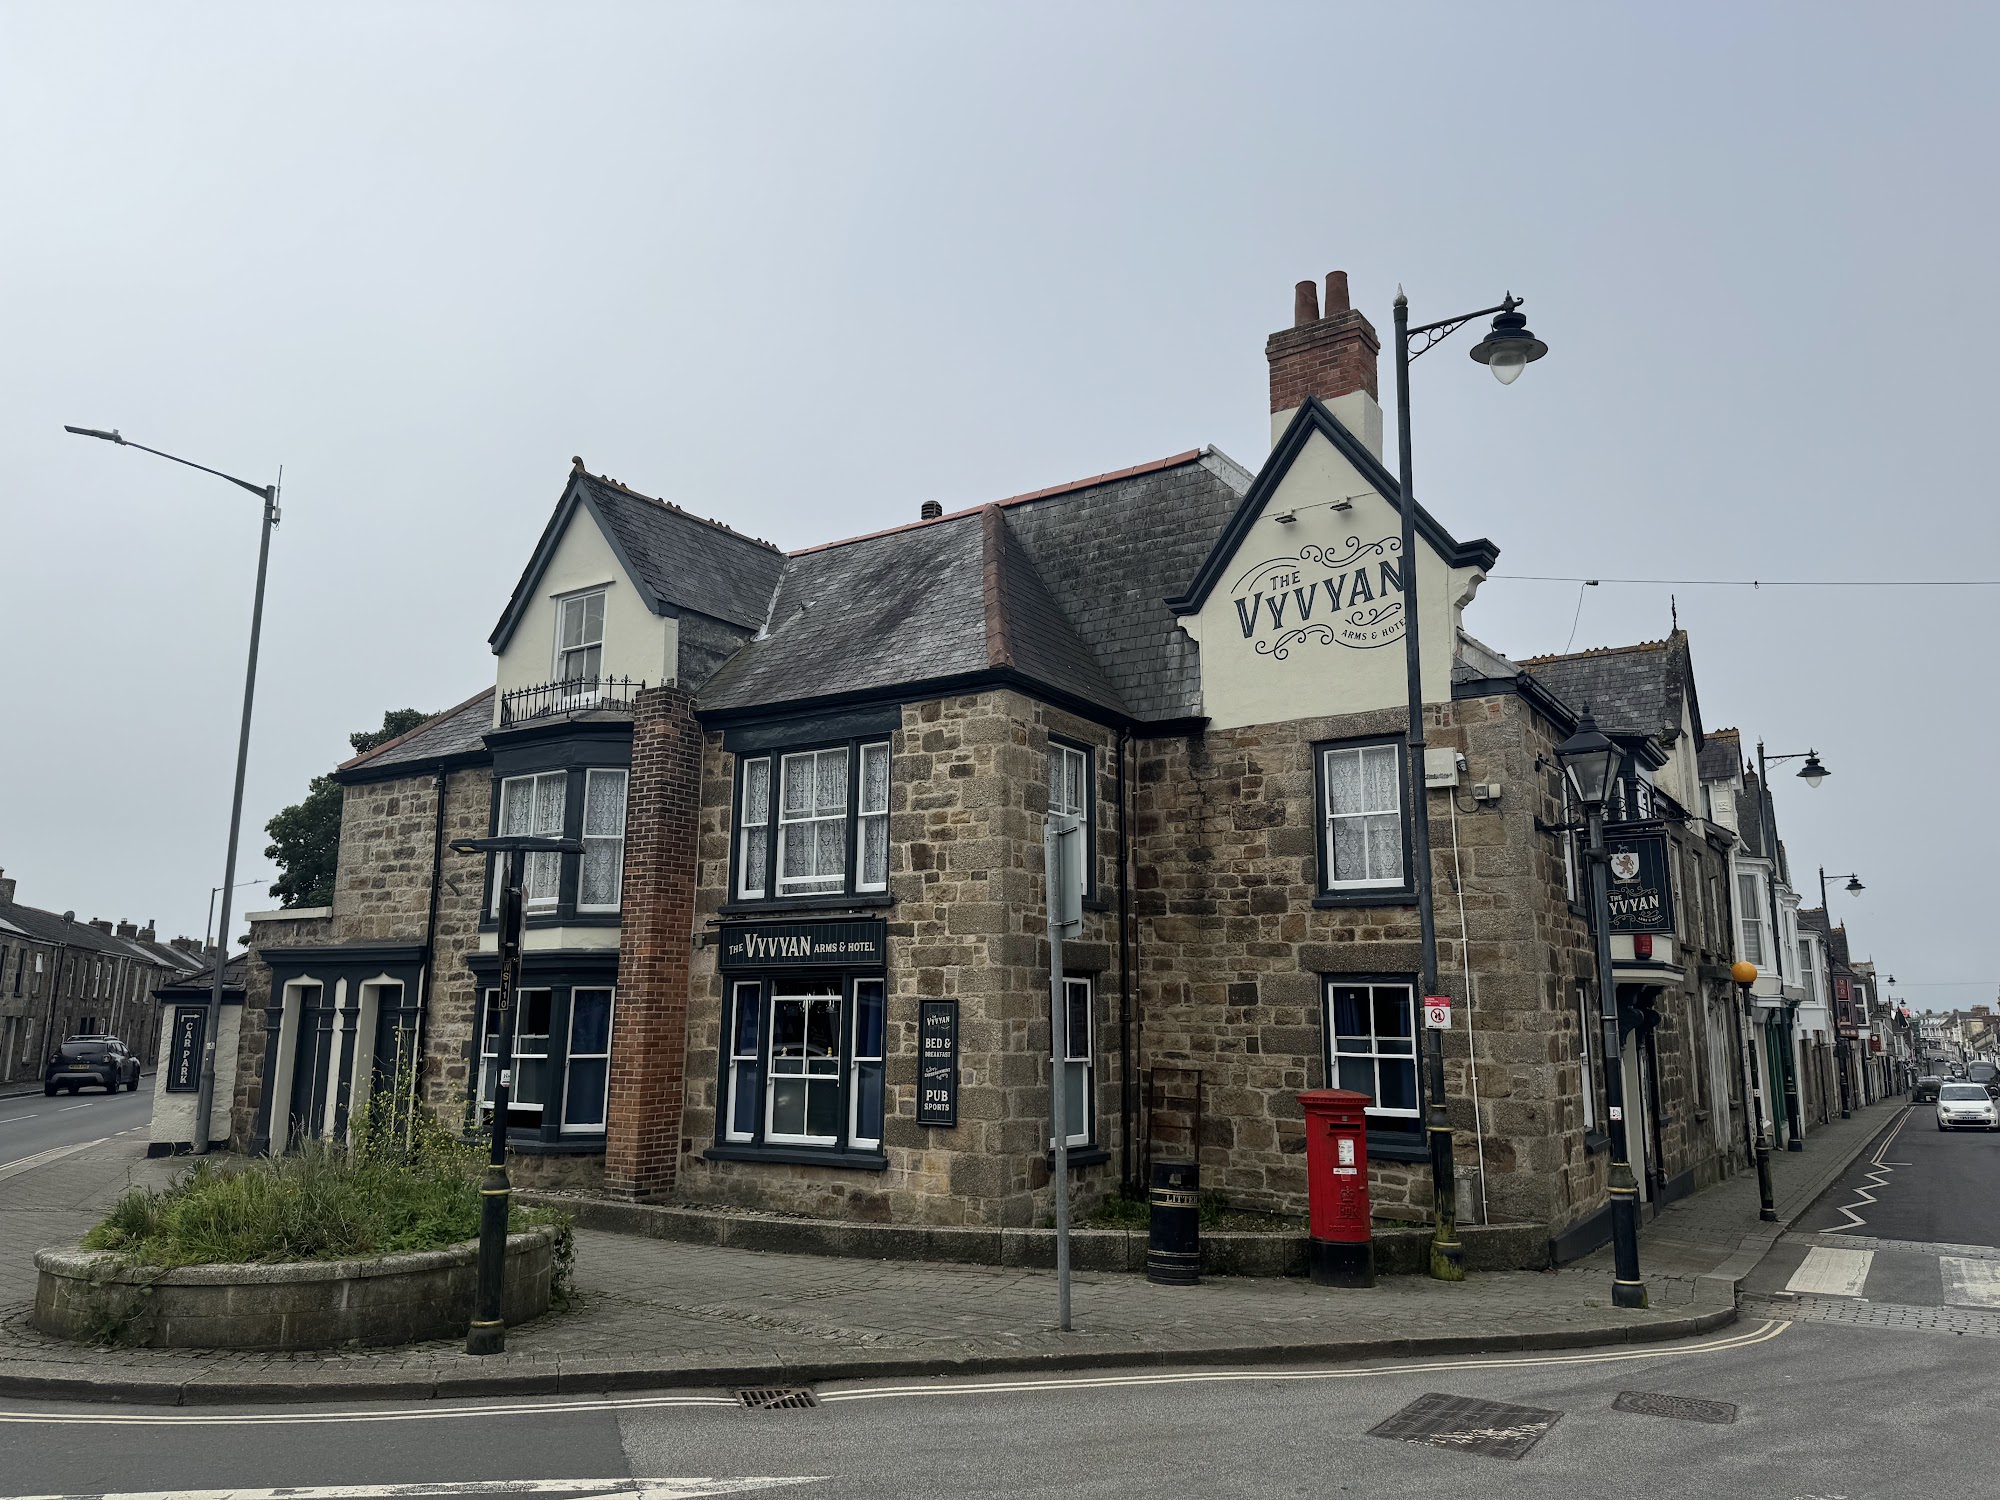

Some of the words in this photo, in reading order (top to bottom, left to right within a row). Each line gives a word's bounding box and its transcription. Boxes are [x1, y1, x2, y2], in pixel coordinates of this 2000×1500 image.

[1270, 571, 1301, 590] THE
[1233, 556, 1404, 639] VYVYAN
[1341, 629, 1367, 640] ARMS
[1371, 632, 1378, 640] &
[1382, 616, 1406, 637] HOTE
[1607, 894, 1660, 915] YVYAN
[728, 943, 744, 955] THE
[744, 933, 812, 958] VYVYAN
[814, 943, 837, 953] ARMS
[839, 942, 846, 952] &
[848, 942, 875, 952] HOTEL
[184, 1022, 194, 1048] CAR
[925, 1037, 943, 1049] BED
[944, 1037, 952, 1049] &
[180, 1050, 190, 1084] PARK
[926, 1089, 949, 1102] PUB
[923, 1102, 950, 1111] SPORTS
[1165, 1194, 1198, 1204] LITTER
